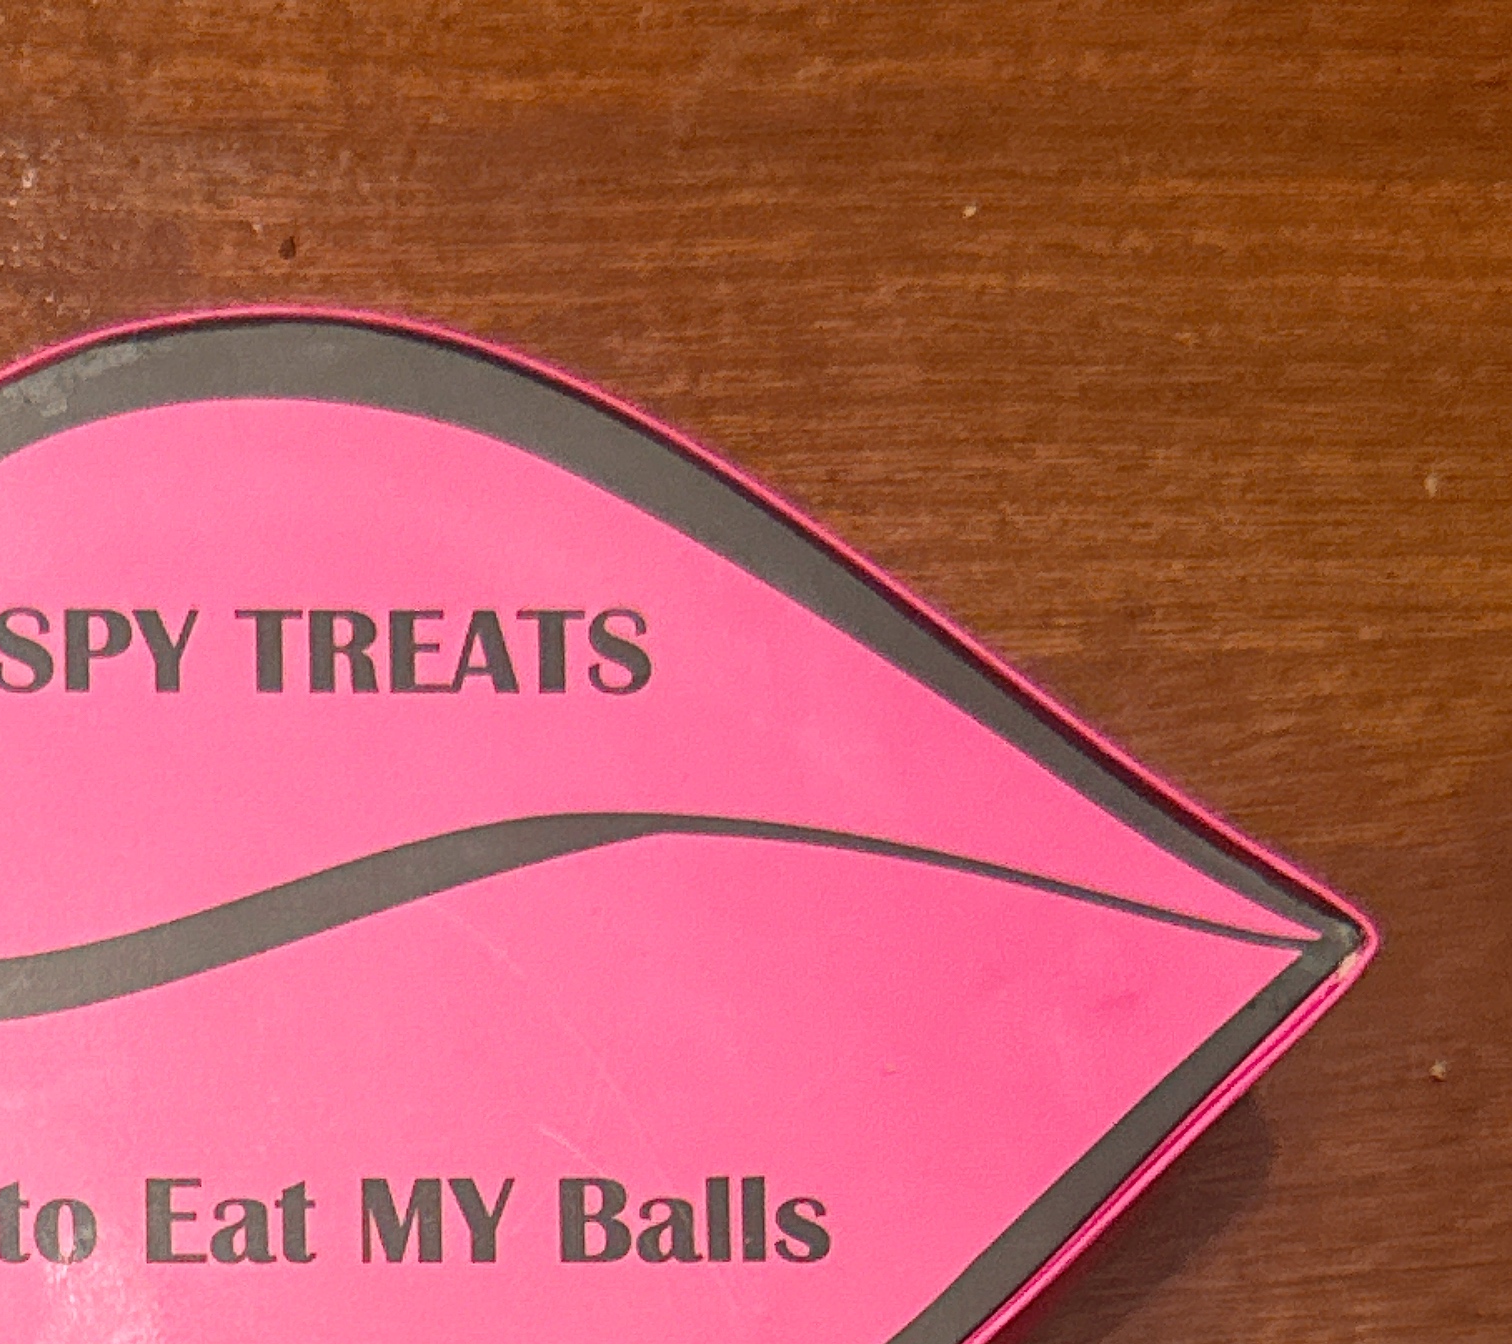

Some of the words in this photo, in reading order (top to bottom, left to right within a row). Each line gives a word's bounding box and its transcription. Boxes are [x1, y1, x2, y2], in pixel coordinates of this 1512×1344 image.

[235, 610, 652, 695] TREATS
[147, 1179, 316, 1264] Eat
[362, 1179, 515, 1264] MY
[560, 1177, 831, 1264] Balls
